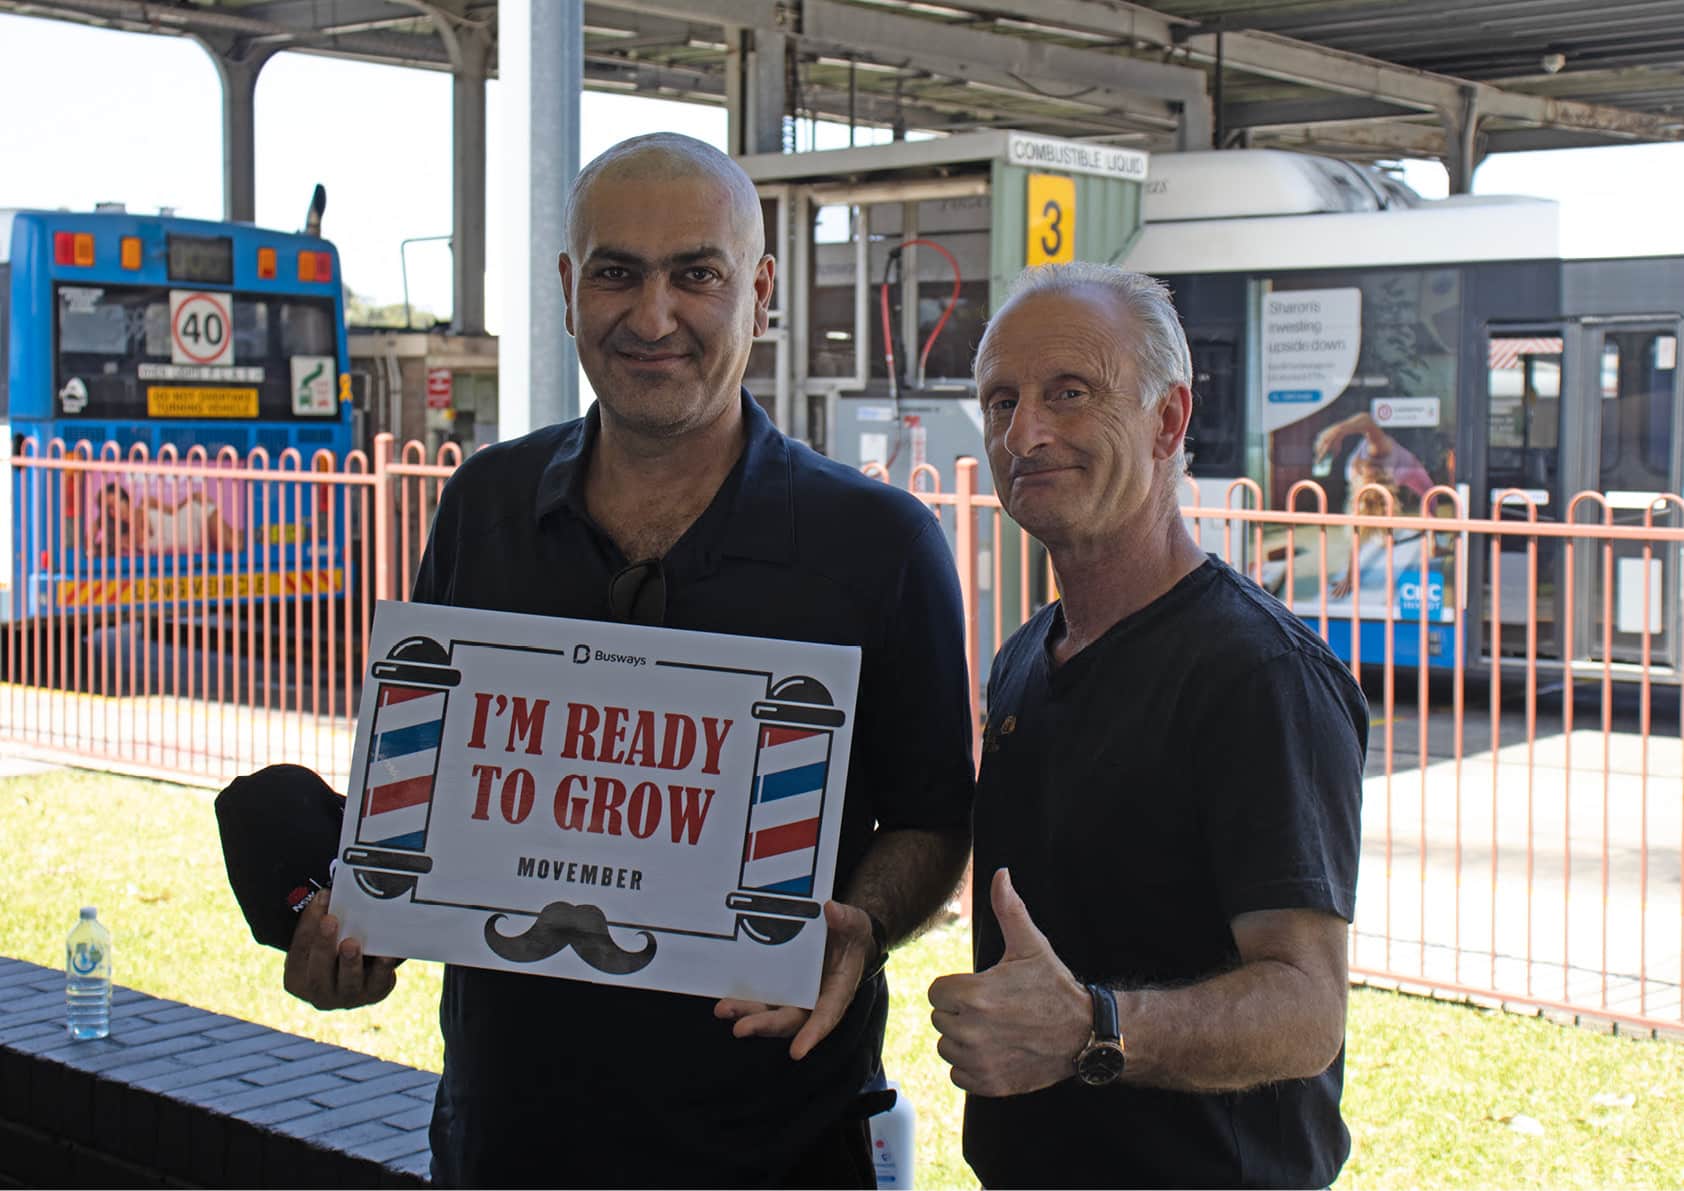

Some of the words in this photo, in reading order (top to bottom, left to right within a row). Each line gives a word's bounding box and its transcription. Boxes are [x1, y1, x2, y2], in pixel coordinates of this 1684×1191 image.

[1014, 140, 1102, 169] COMBUSTIBLE
[1108, 152, 1144, 174] LIQUID
[1040, 200, 1063, 256] 3
[182, 312, 223, 345] 40
[594, 650, 647, 668] Busways
[560, 702, 734, 775] READY
[471, 763, 536, 825] TO
[553, 774, 716, 846] GROW
[516, 856, 643, 891] MOVEMBER
